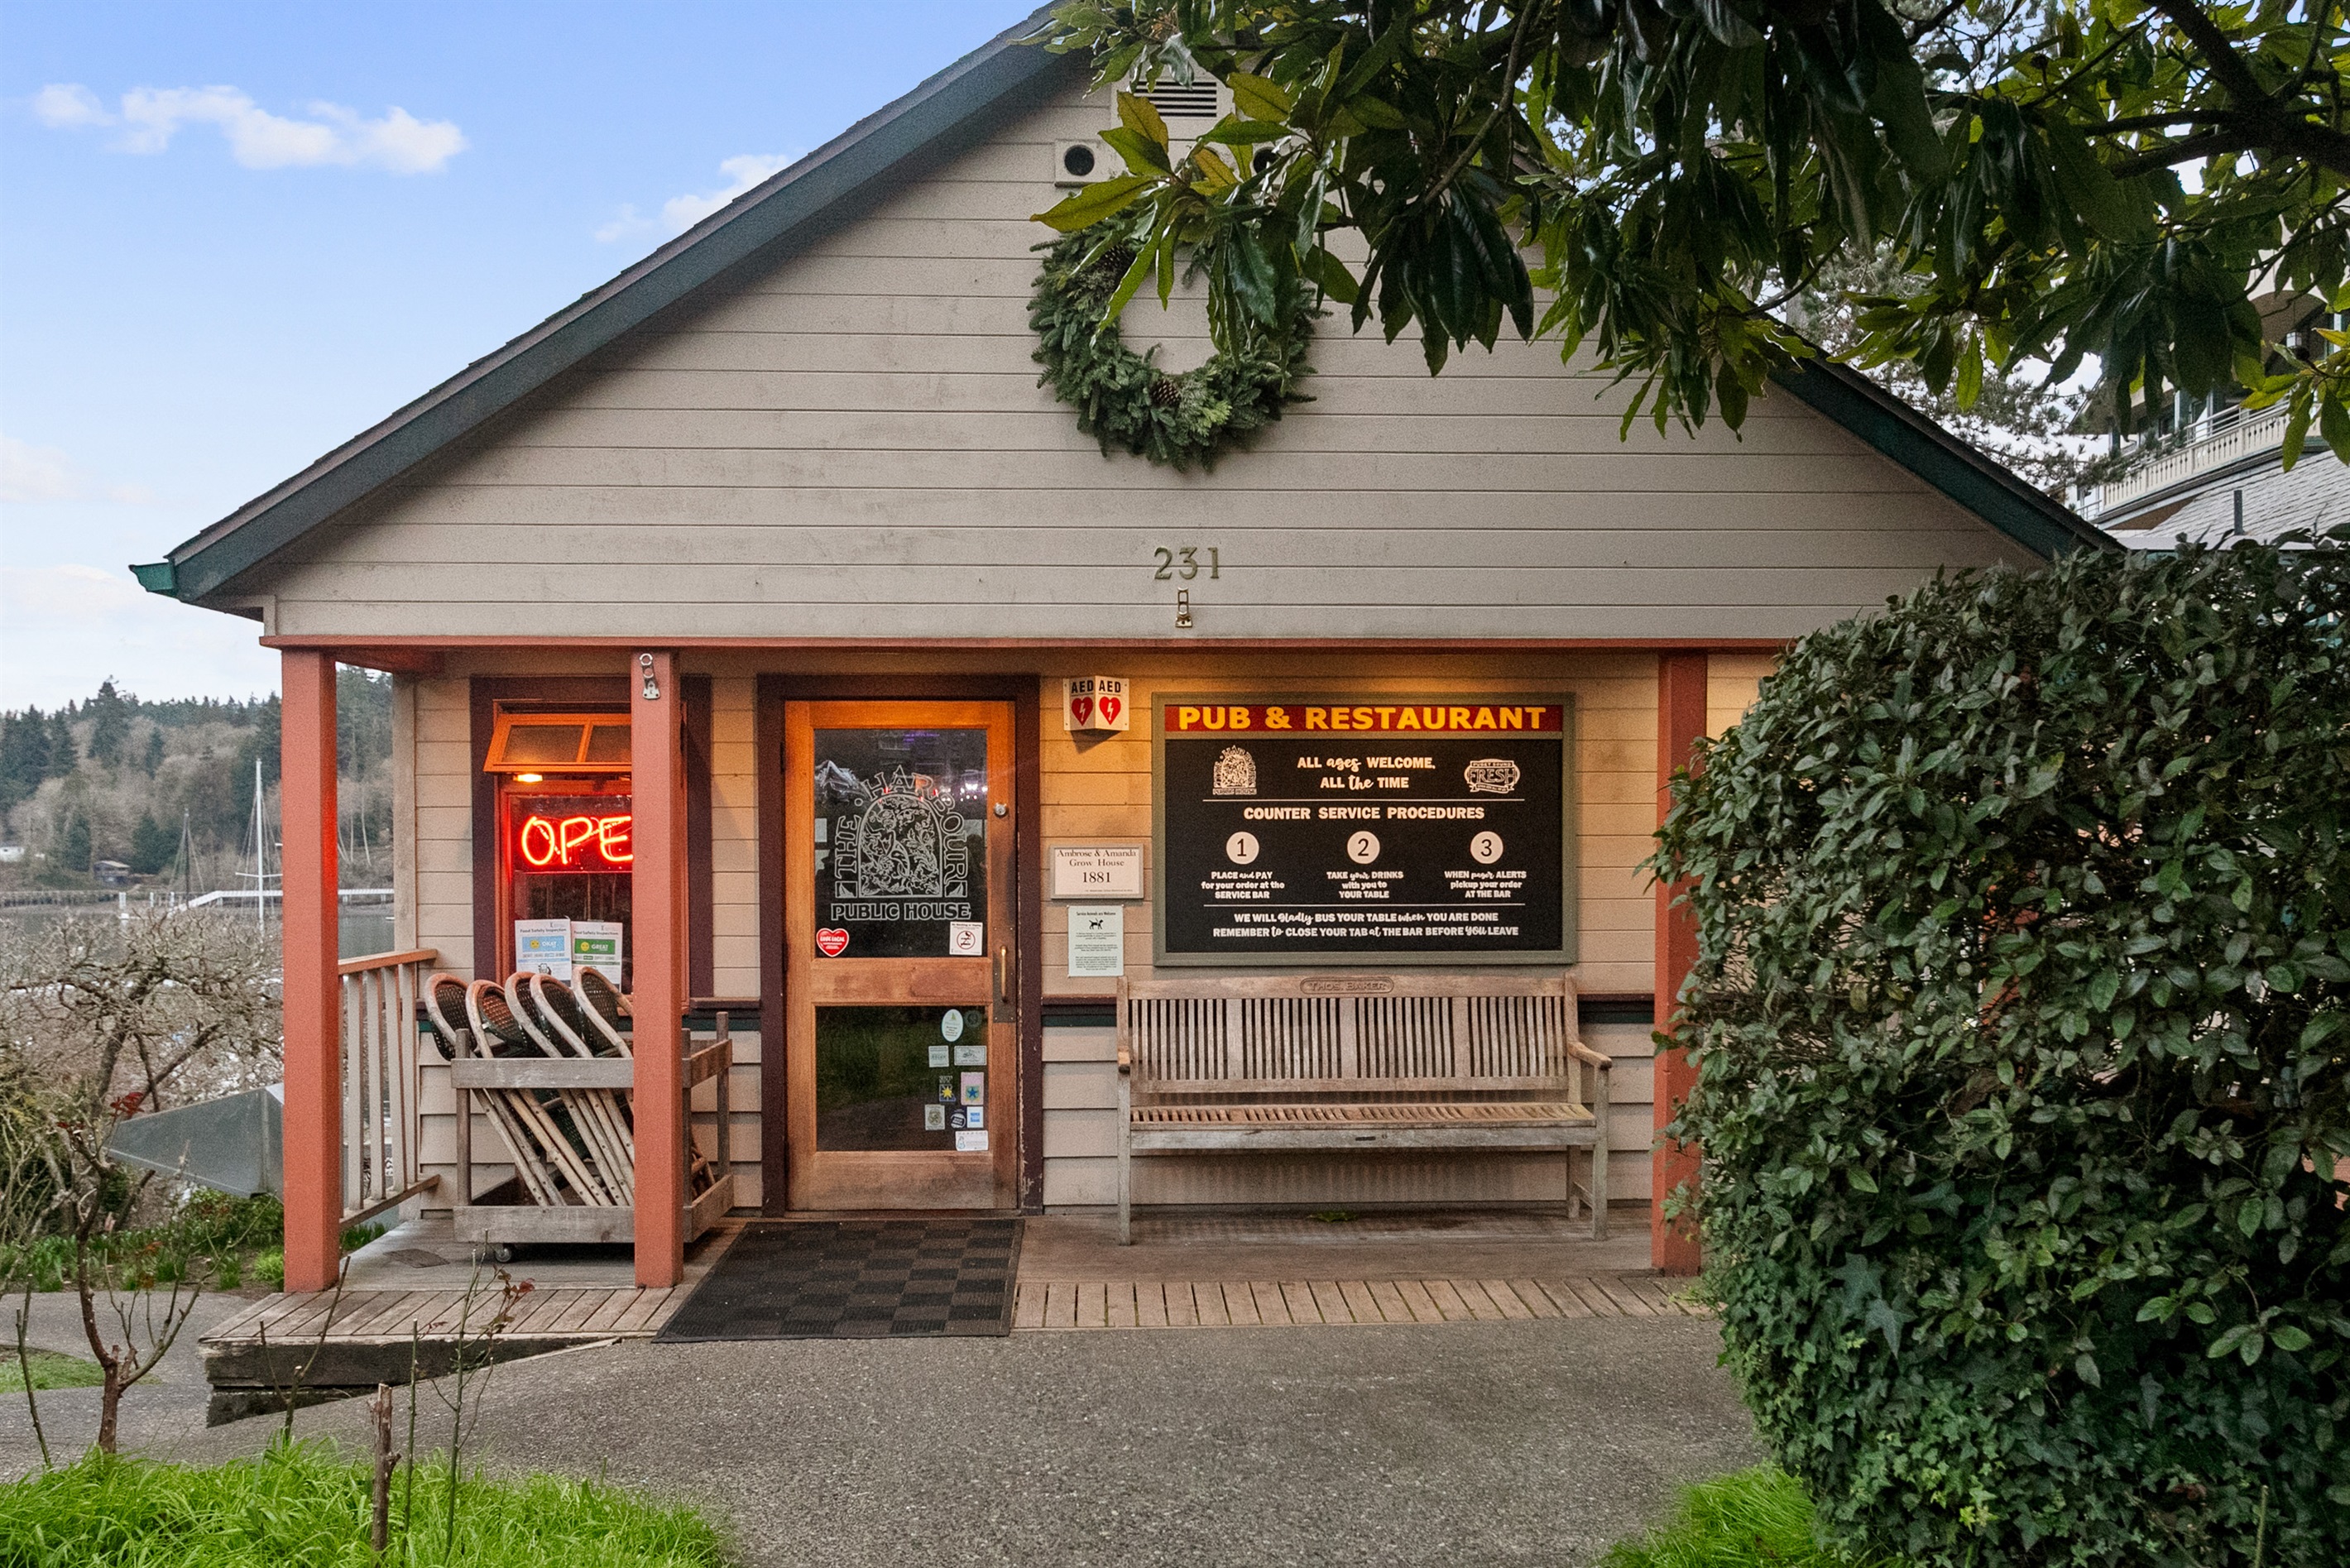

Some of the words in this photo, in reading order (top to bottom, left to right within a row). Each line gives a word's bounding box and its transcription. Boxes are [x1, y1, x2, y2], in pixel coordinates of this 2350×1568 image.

[1153, 546, 1219, 580] 231
[1071, 680, 1094, 693] AED
[1099, 680, 1121, 693] AED
[1179, 707, 1251, 730] PUB
[1265, 707, 1292, 729] &
[1306, 707, 1546, 729] RESTAURANT
[1297, 757, 1322, 769] ALL
[1326, 757, 1361, 773] ages
[1366, 757, 1436, 770] WELCOME,
[1320, 777, 1345, 789] ALL
[1348, 774, 1374, 790] the
[1377, 777, 1409, 789] TIME
[1469, 768, 1516, 784] FRESH
[1244, 807, 1311, 820] COUNTER
[1318, 807, 1380, 820] SERVICE
[1387, 807, 1484, 819] PROCEDURES
[861, 765, 968, 885] HARBOUR
[521, 816, 634, 866] OPE
[835, 815, 861, 880] THE
[1237, 838, 1247, 856] 1
[1357, 838, 1369, 856] 2
[1480, 839, 1492, 856] 3
[1083, 871, 1110, 883] 1881
[1211, 871, 1239, 880] PLACE
[1239, 871, 1255, 880] and
[1255, 871, 1273, 880] PAY
[1326, 871, 1349, 880] TAKE
[1350, 871, 1370, 881] your
[1201, 881, 1215, 889] for
[1216, 882, 1235, 890] your
[1235, 881, 1259, 889] order
[1259, 881, 1269, 889] at
[1270, 881, 1285, 889] the
[1341, 881, 1360, 889] with
[1361, 882, 1377, 890] you
[1450, 880, 1478, 889] pickup
[1479, 881, 1499, 889] your
[1499, 880, 1523, 889] order
[1215, 891, 1251, 899] SERVICE
[1252, 891, 1270, 899] BAR
[1339, 890, 1362, 899] YOUR
[1363, 890, 1389, 899] TABLE
[831, 903, 900, 921] PUBLIC
[904, 902, 971, 920] HOUSE
[1234, 913, 1250, 923] WE
[1252, 913, 1277, 923] WILL
[1314, 913, 1336, 923] BUS
[1336, 913, 1364, 923] YOUR
[1366, 913, 1397, 922] TABLE
[1398, 913, 1426, 922] when
[1426, 913, 1447, 922] YOU
[1448, 913, 1469, 922] ARE
[1470, 913, 1499, 921] DONE
[1213, 928, 1270, 937] REMEMBER
[1271, 926, 1284, 937] to
[1285, 928, 1318, 937] CLOSE
[1319, 928, 1347, 937] YOUR
[1349, 928, 1369, 937] TAB
[1369, 926, 1382, 937] at
[1382, 928, 1402, 936] THE
[1402, 928, 1422, 936] BAR
[1425, 927, 1464, 936] BEFORE
[1487, 927, 1519, 936] LEAVE
[1346, 981, 1388, 991] BAKER
